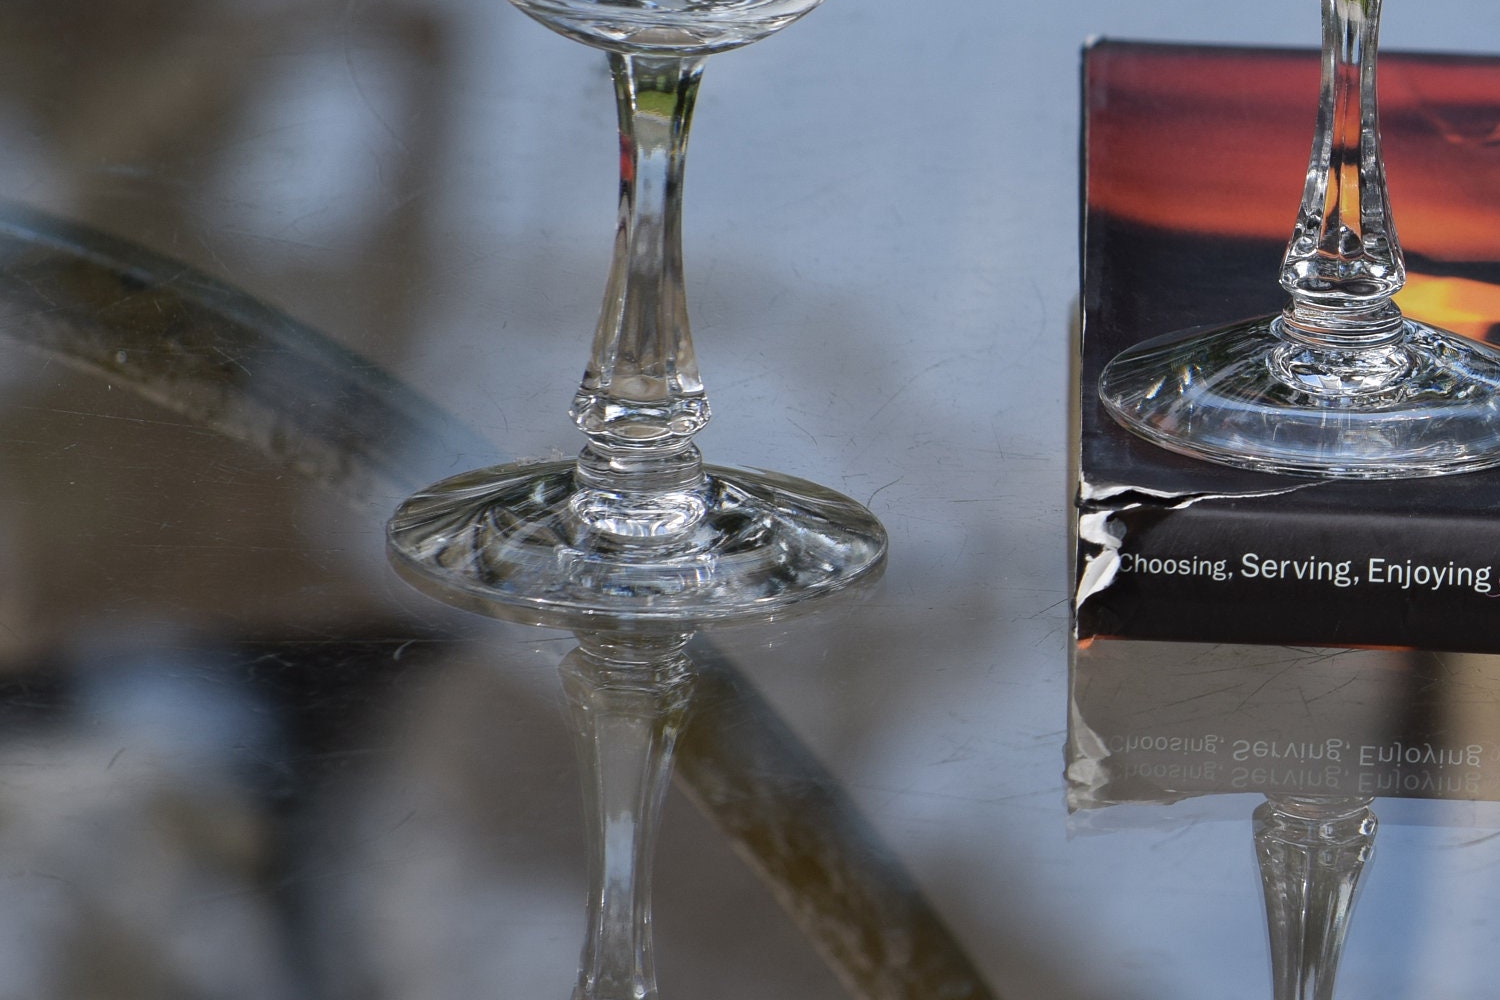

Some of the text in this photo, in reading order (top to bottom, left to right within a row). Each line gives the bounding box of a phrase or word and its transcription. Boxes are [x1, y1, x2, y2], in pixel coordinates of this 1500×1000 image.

[1119, 553, 1233, 581] Choosing,
[1240, 552, 1359, 587] Serving,
[1368, 557, 1492, 593] Enjoying
